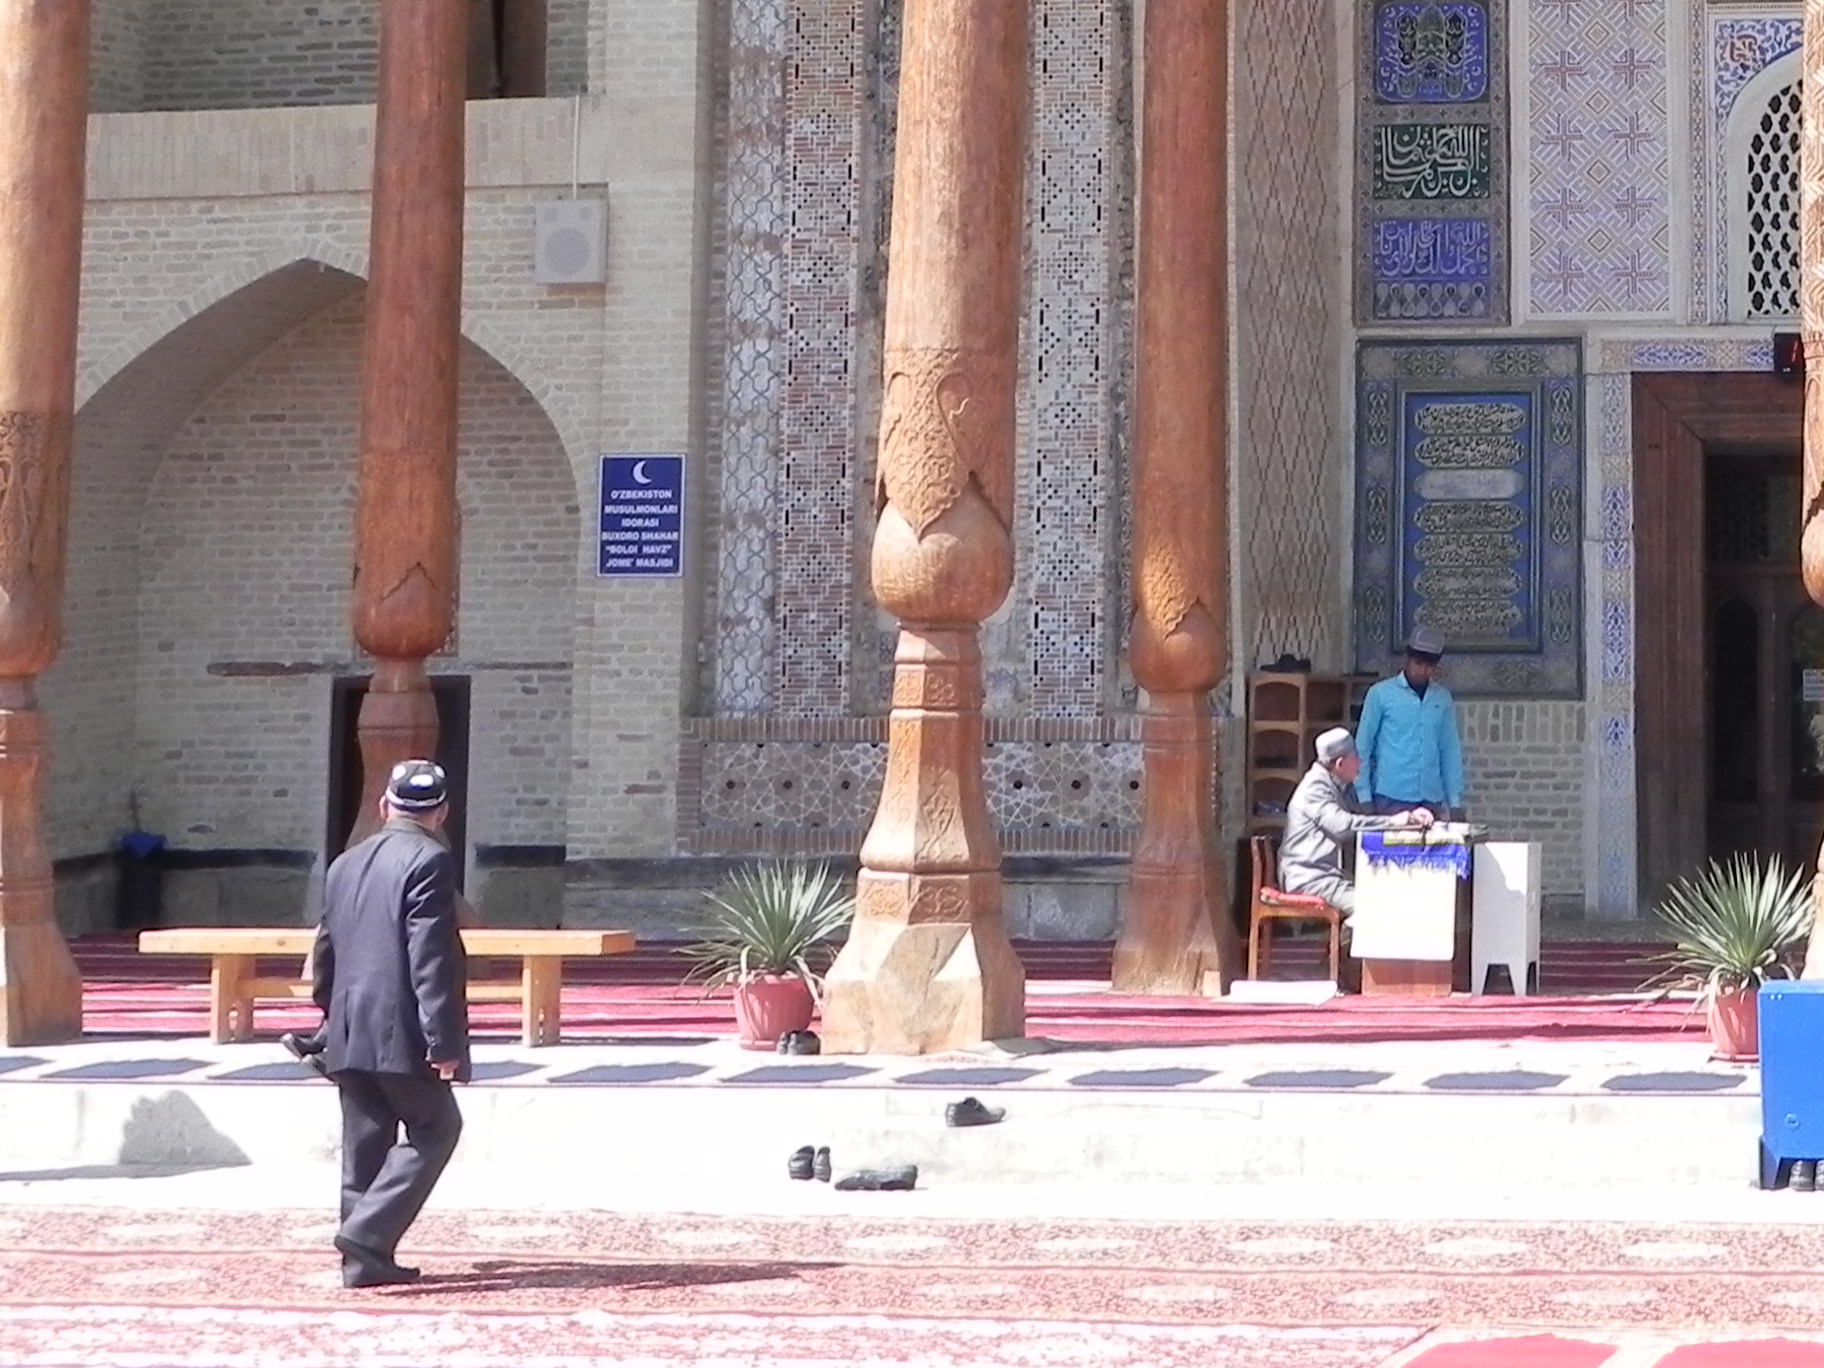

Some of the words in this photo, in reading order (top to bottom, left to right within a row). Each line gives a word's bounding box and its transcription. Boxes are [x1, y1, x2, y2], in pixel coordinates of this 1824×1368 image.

[604, 504, 678, 514] MUSULMONLARI
[621, 518, 659, 527] IDORASI
[602, 531, 639, 541] BUXORO
[641, 531, 678, 541] SHAHAR
[636, 557, 673, 567] MASJIDI
